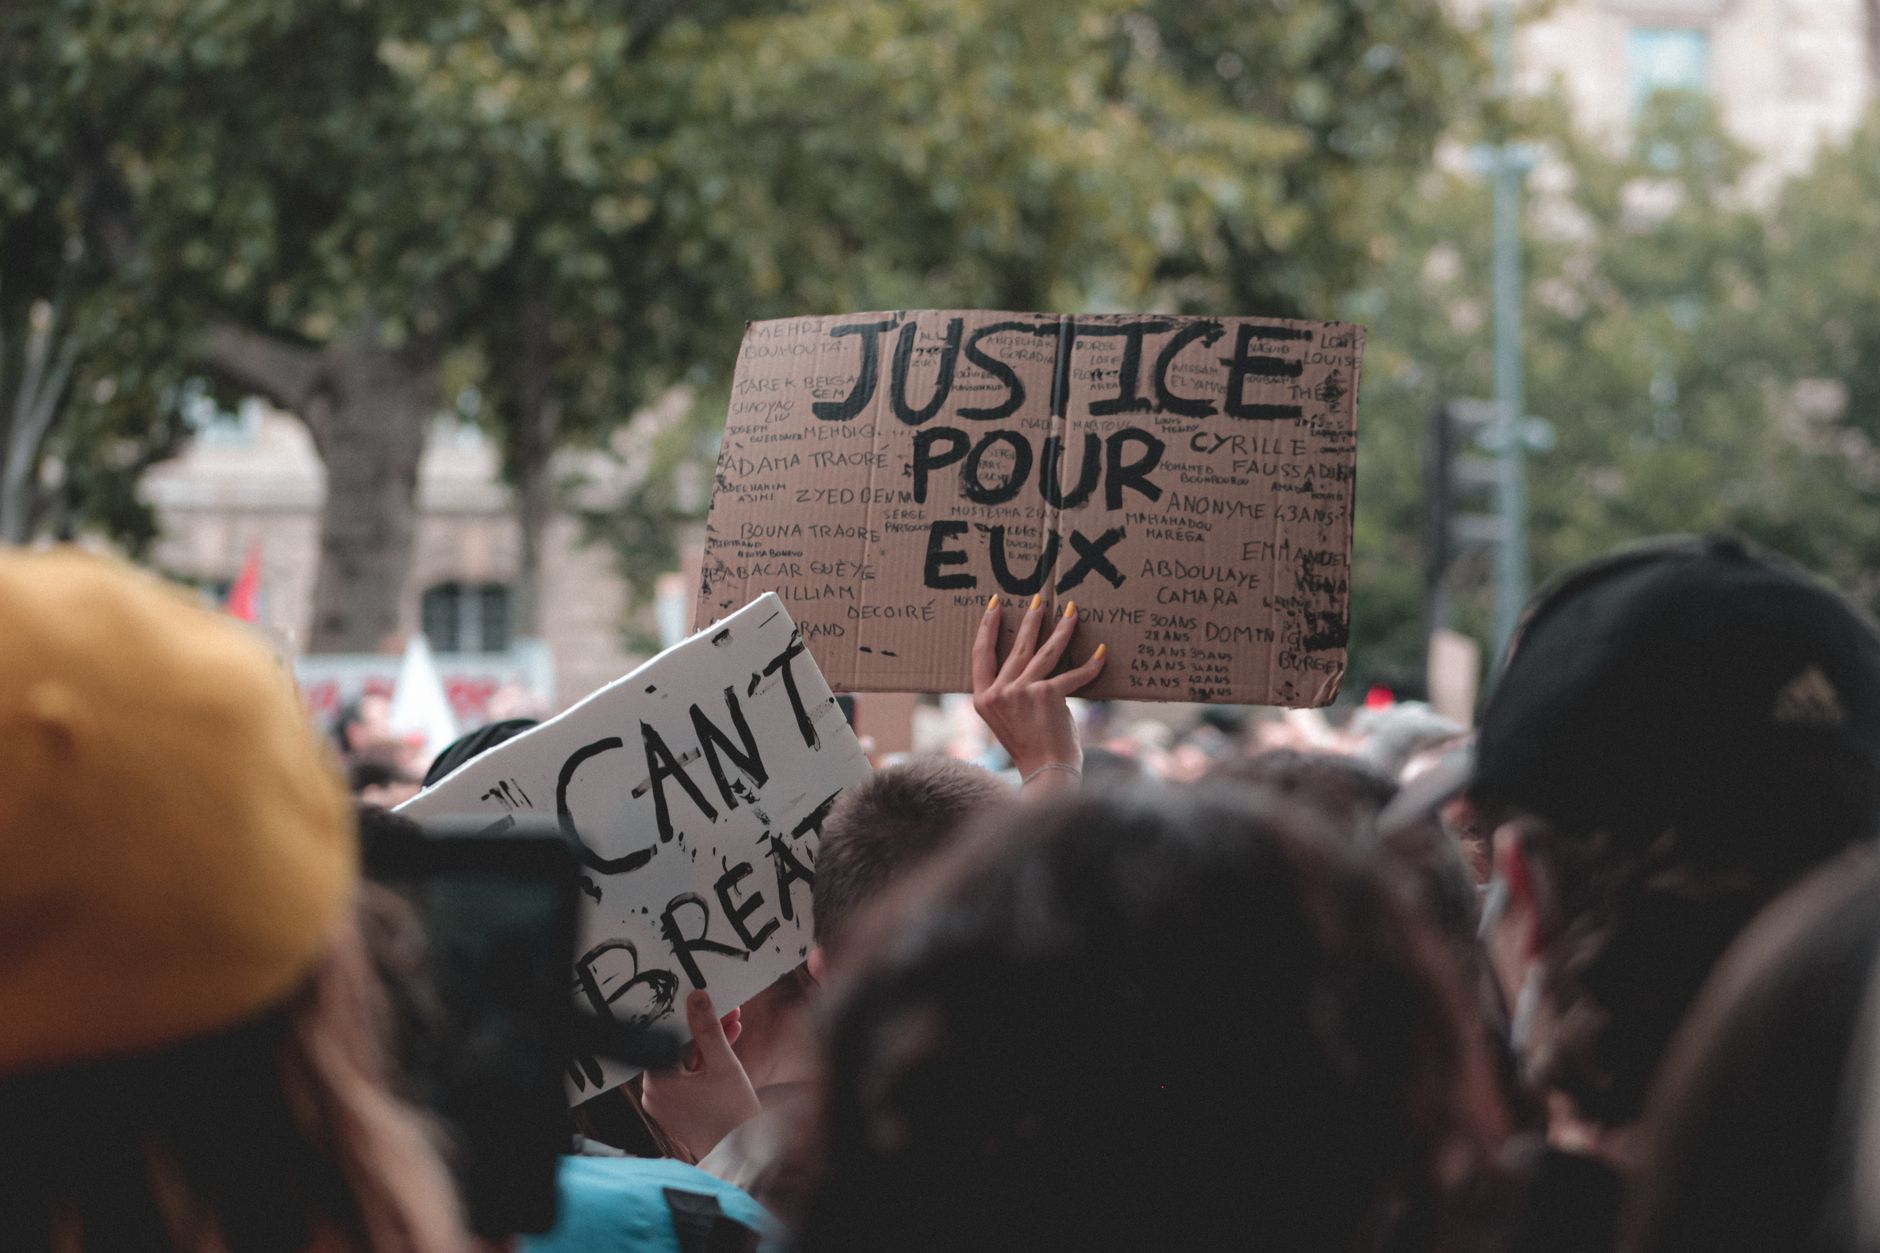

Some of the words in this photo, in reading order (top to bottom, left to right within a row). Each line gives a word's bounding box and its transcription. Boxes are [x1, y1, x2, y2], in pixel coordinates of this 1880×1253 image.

[812, 315, 1313, 426] JUSTICE
[735, 378, 797, 397] TAREK
[1189, 430, 1308, 457] CYRILLE
[722, 453, 801, 478] ADAMA
[912, 425, 1166, 512] POUR
[795, 486, 855, 506] ZYED
[1166, 491, 1267, 521] ANONYME
[882, 509, 927, 521] SERGE
[740, 521, 802, 540] BOUNA
[807, 523, 881, 544] TRAORE
[924, 519, 1128, 598] EUX
[1140, 556, 1262, 590] ABDOULAYE
[1156, 585, 1239, 611] CAMARA
[1053, 604, 1147, 625] AONYME
[794, 620, 846, 639] RAND
[556, 630, 822, 876] CAN'T
